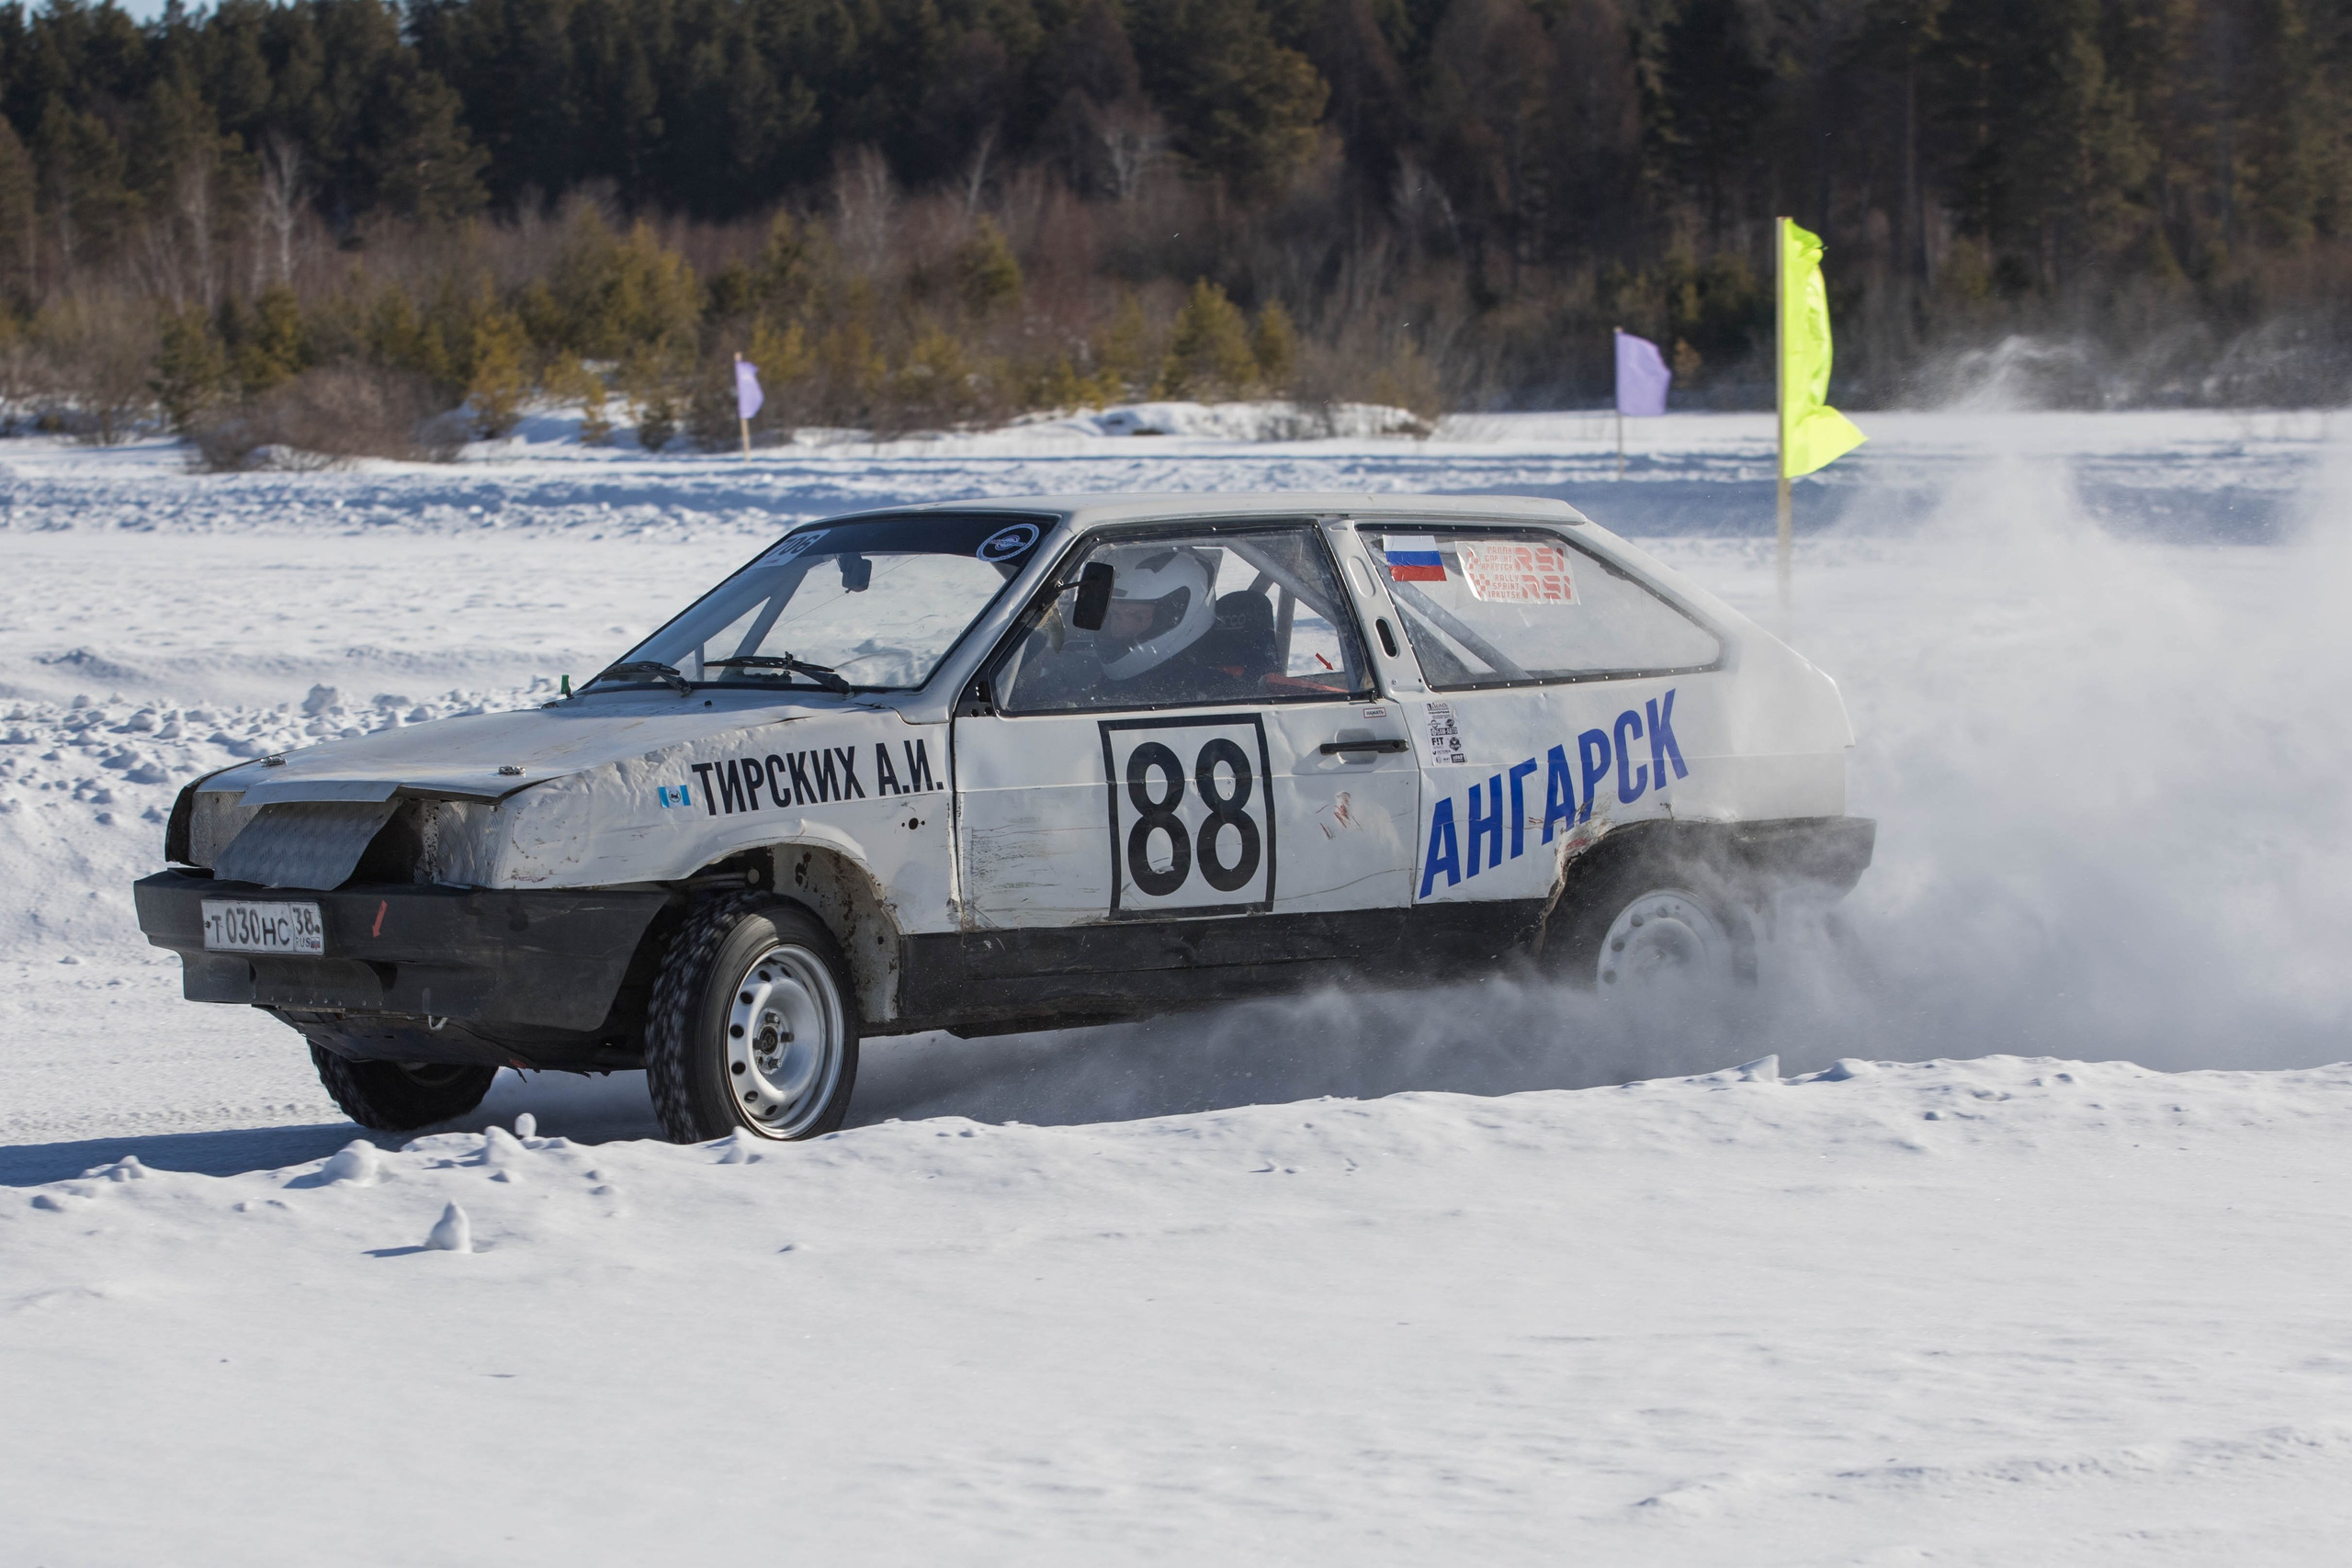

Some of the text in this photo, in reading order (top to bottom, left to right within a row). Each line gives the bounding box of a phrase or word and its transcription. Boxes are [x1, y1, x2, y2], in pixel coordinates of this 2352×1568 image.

[1492, 582, 1520, 591] SPRINT
[1494, 573, 1520, 582] RALLY
[1488, 591, 1521, 599] IRKUTSK
[691, 739, 944, 816] ТИРСКИХ А.И.
[1419, 688, 1689, 899] АНГАРСК
[1126, 738, 1261, 897] 88
[292, 908, 313, 935] 38
[295, 937, 311, 948] RUS
